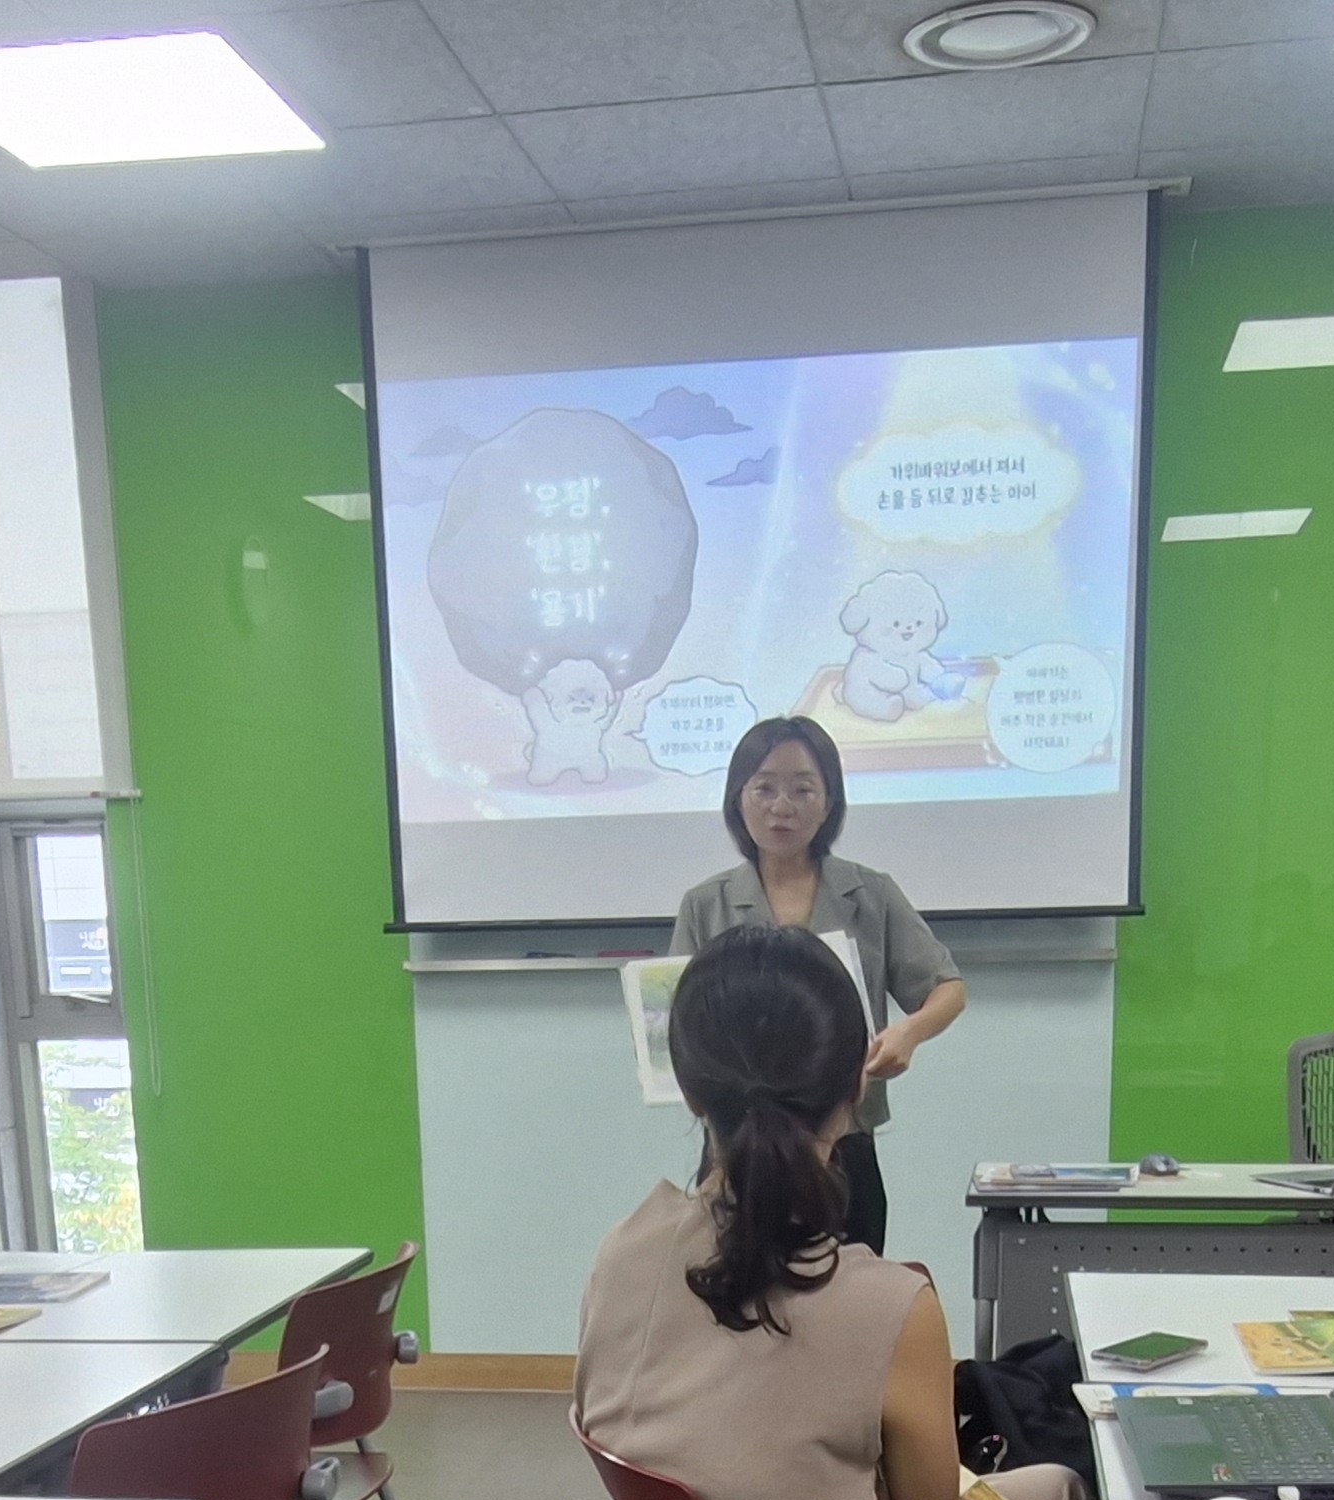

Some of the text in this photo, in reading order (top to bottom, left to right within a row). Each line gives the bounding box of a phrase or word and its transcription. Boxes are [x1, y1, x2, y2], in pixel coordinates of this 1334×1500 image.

[889, 456, 992, 480] 가위바위보에서
[877, 480, 1037, 510] 손을 등 뒤로 감추는 아이
